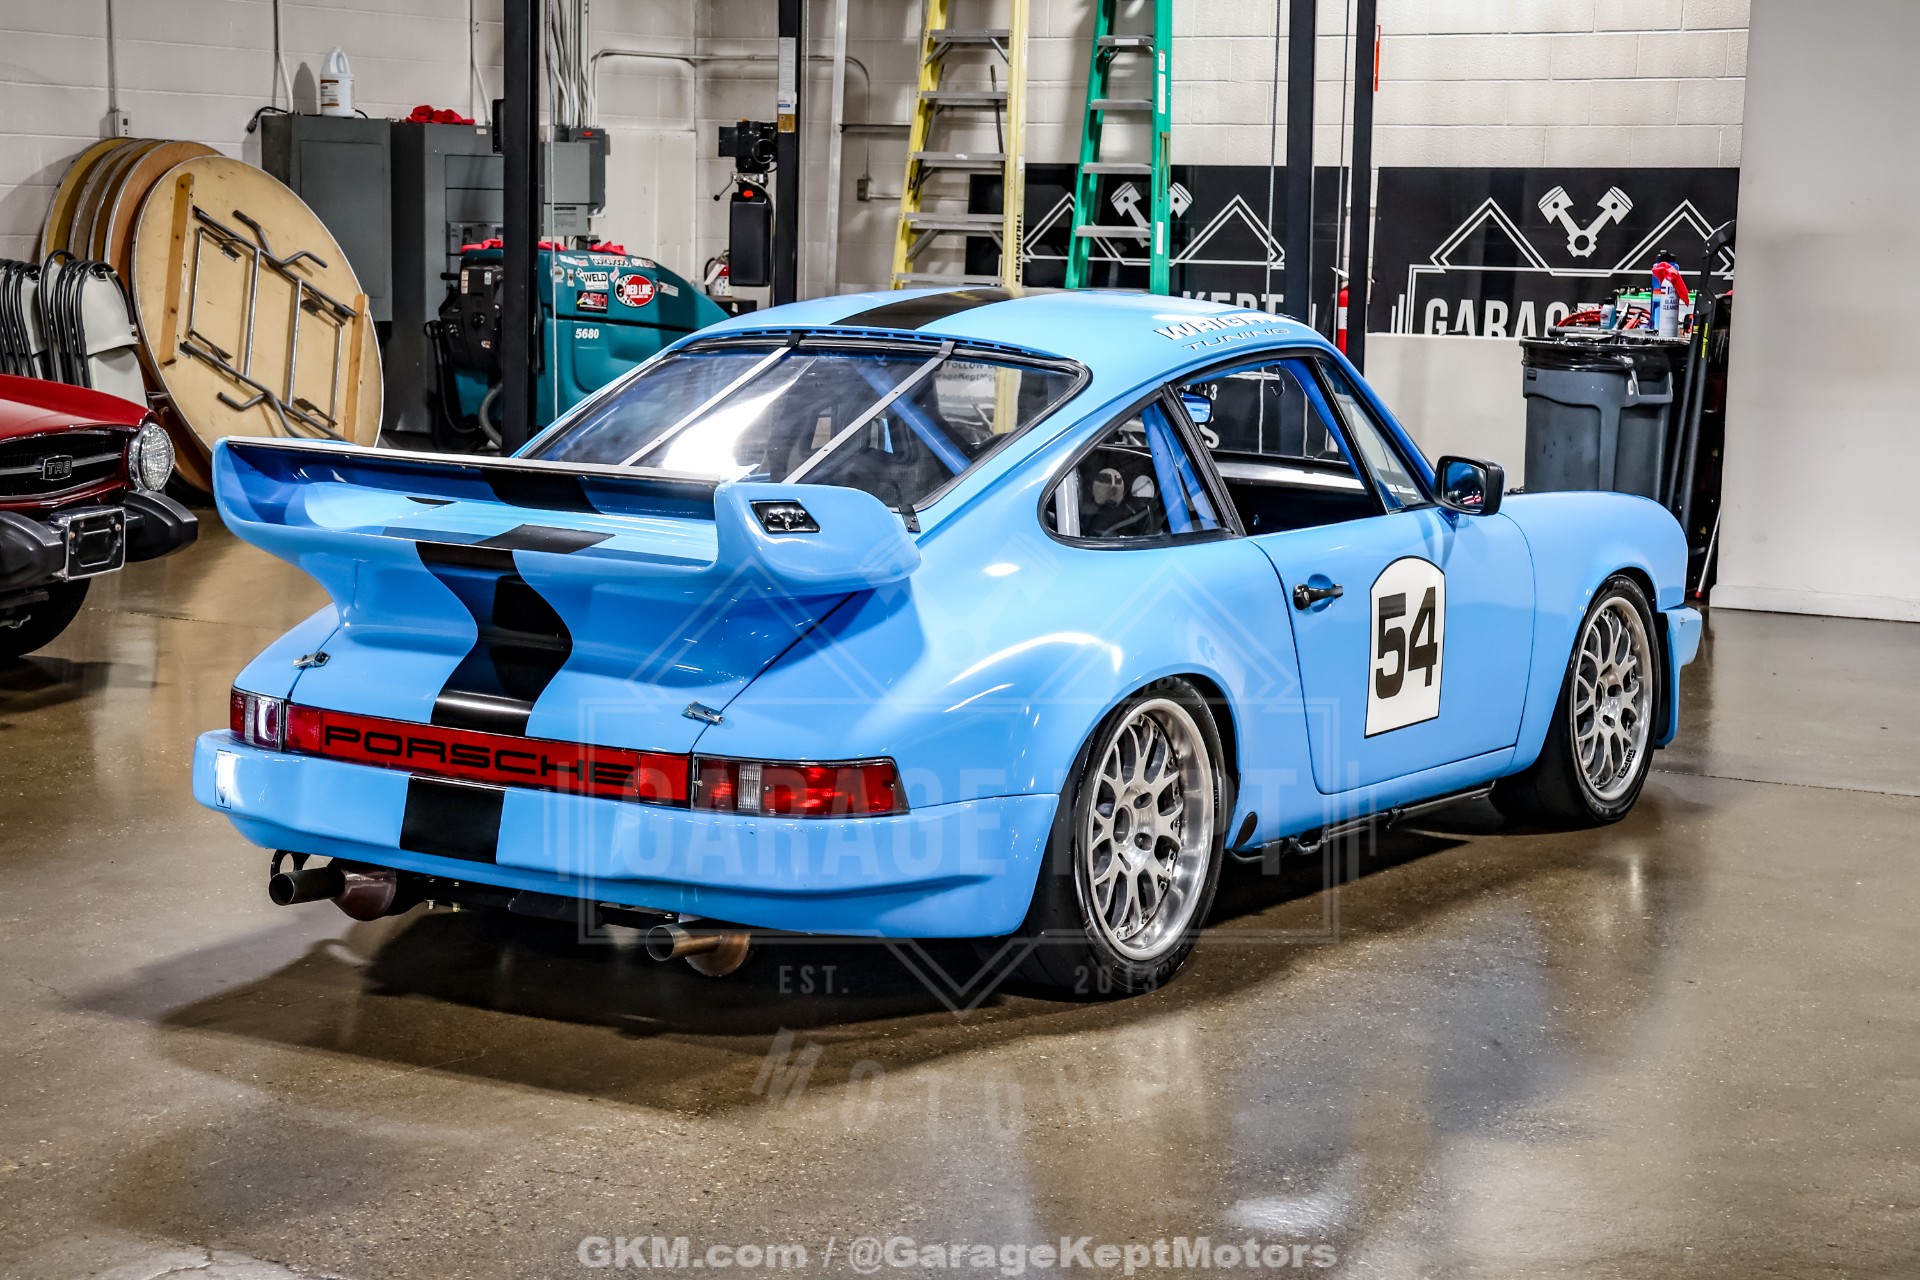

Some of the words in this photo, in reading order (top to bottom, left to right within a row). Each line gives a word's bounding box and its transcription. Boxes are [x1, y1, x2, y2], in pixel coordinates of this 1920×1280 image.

[583, 273, 608, 282] WELD
[626, 284, 638, 295] RED
[638, 284, 653, 295] LINE
[1424, 297, 1600, 338] GARA
[575, 328, 600, 339] 5680
[1182, 328, 1291, 350] TUNING
[1375, 586, 1438, 700] 54
[324, 725, 635, 788] PORSCHE
